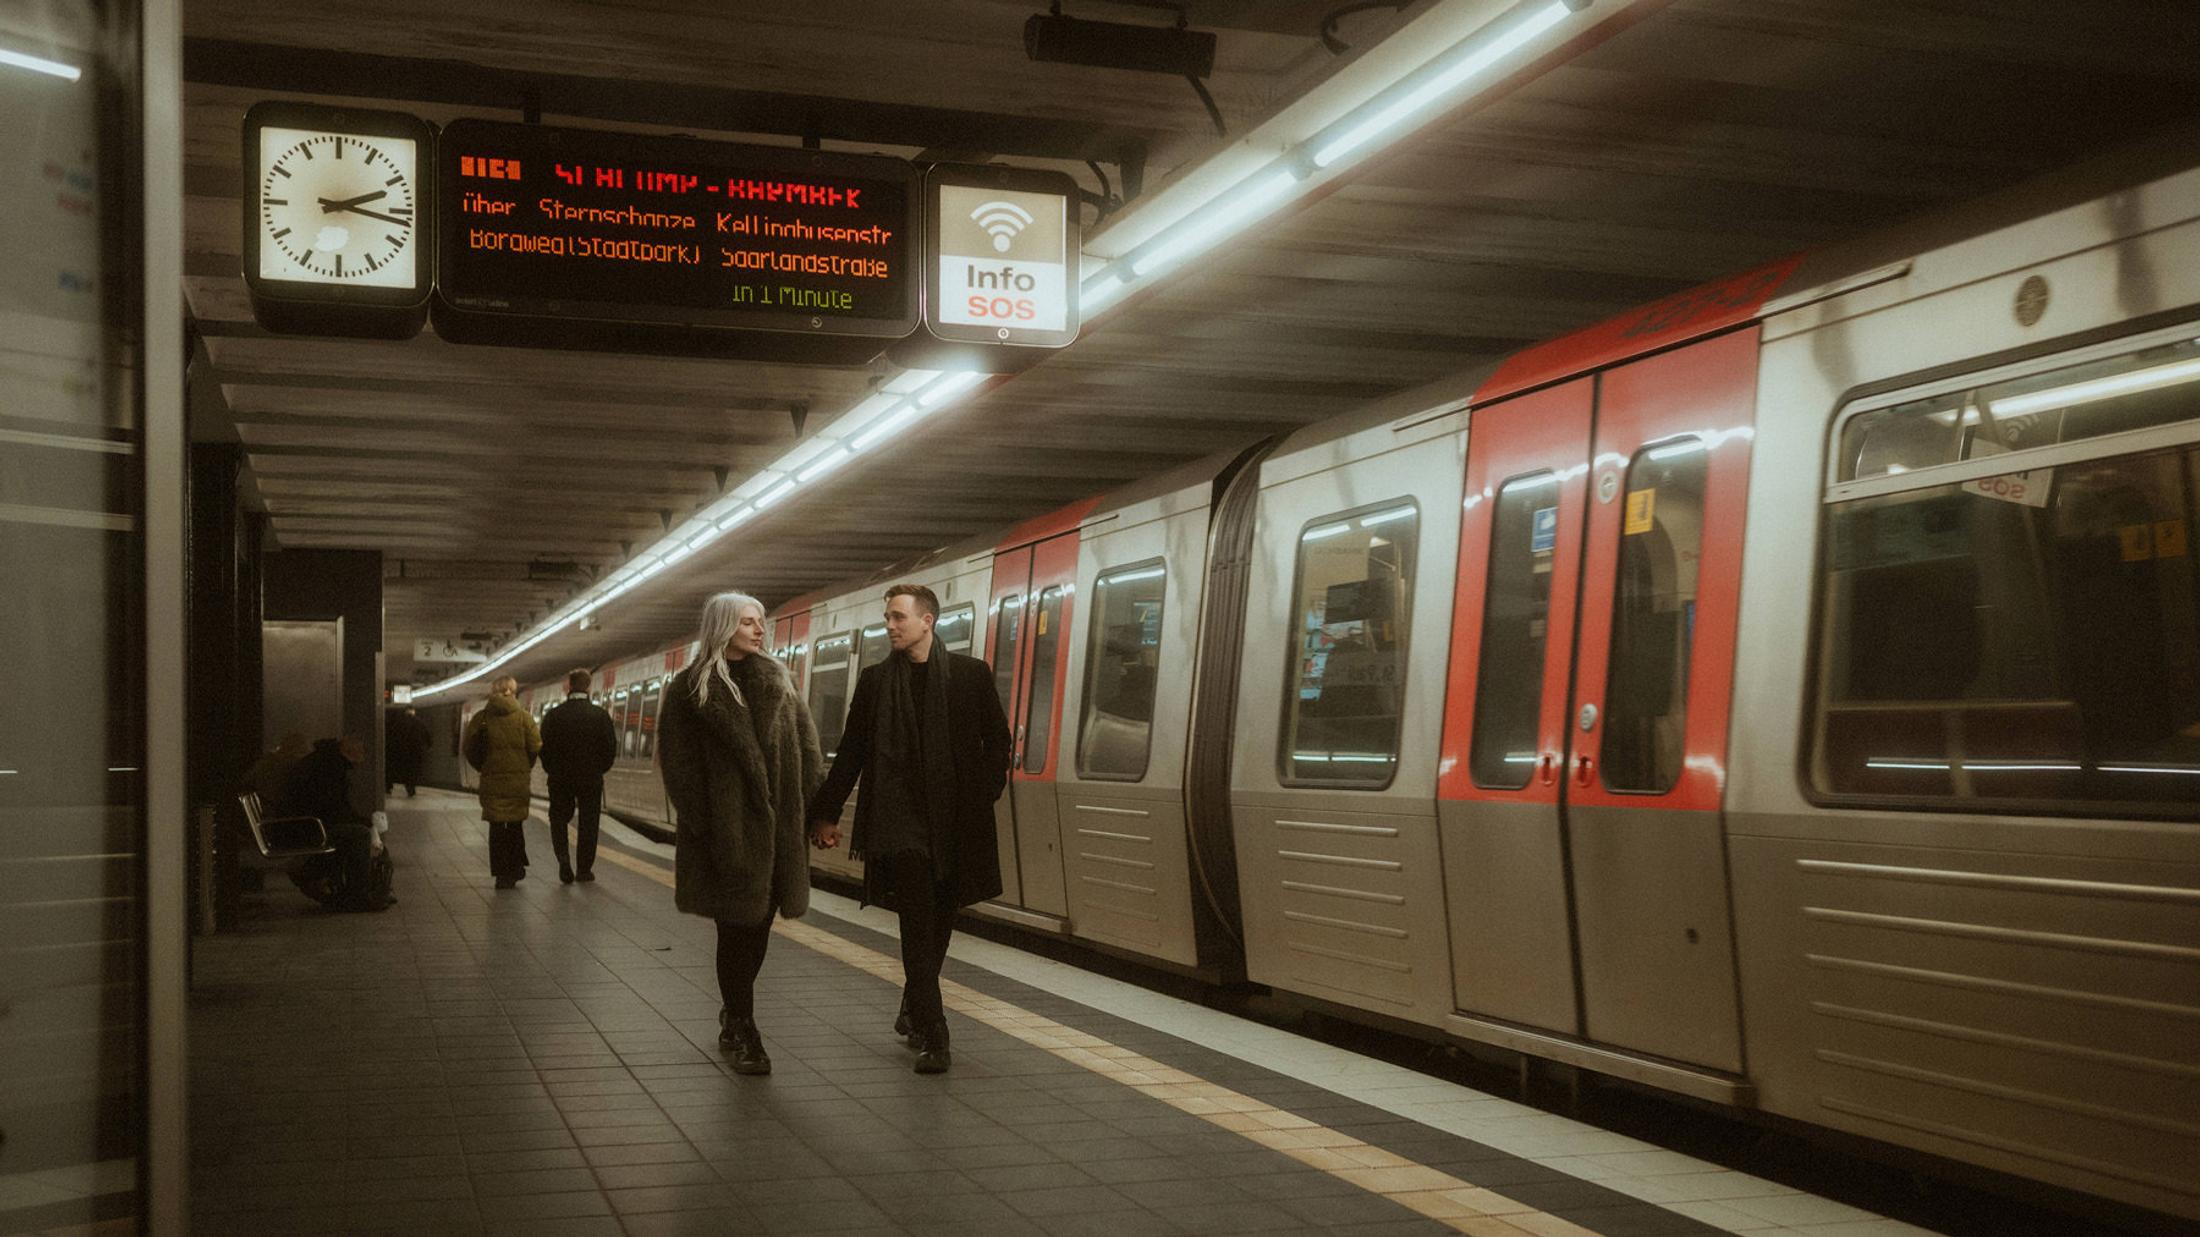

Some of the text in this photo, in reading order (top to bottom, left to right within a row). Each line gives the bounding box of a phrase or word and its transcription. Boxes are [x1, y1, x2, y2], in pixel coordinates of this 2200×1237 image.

[967, 264, 1036, 292] Info
[779, 287, 852, 309] Minute
[968, 295, 1036, 321] SOS
